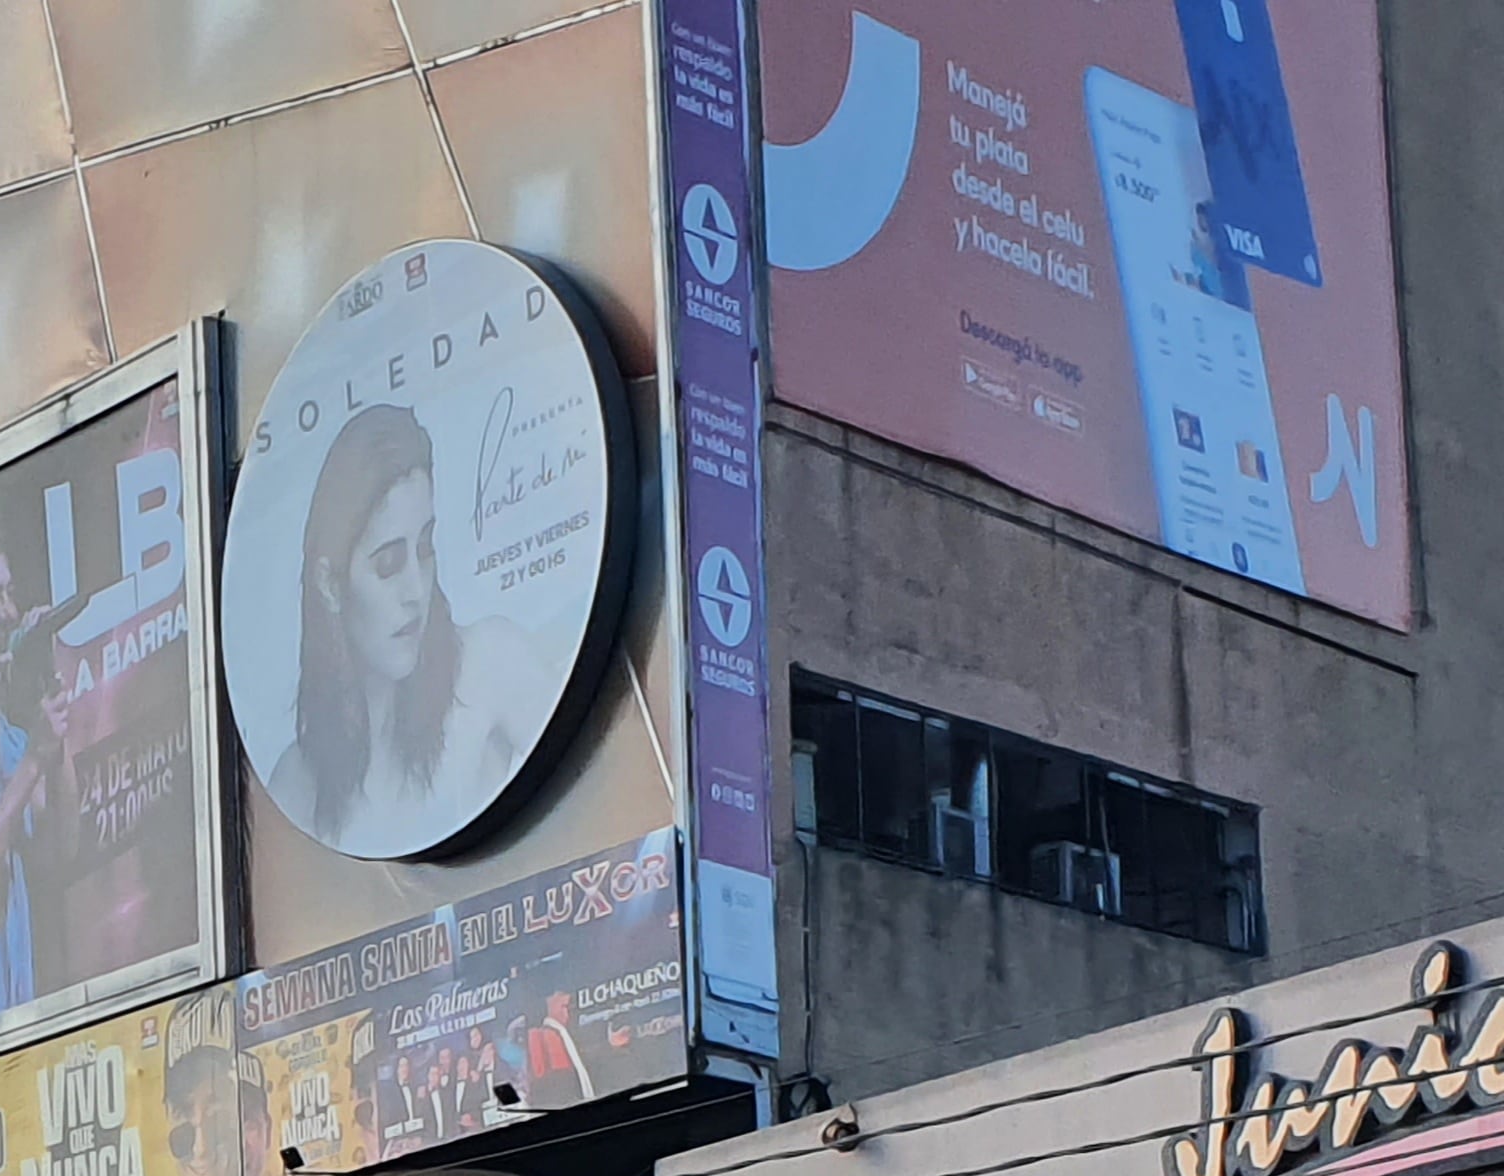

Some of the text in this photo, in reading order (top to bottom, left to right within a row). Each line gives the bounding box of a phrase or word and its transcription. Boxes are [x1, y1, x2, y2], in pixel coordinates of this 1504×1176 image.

[946, 60, 1028, 132] Manejá
[950, 115, 1030, 175] tu plata
[951, 161, 1086, 248] desde el celu
[954, 217, 969, 252] y
[972, 214, 1044, 277] hacela
[1223, 223, 1265, 261] VISA
[685, 281, 741, 316] SANCOR
[685, 299, 743, 336] SEGUROS
[254, 285, 546, 455] SOLEDAD
[474, 540, 523, 576] JUEVES
[535, 509, 591, 549] VIERNES
[102, 602, 189, 683] BARRA
[242, 953, 356, 1032] SEMANA
[360, 921, 454, 992] SANTA
[459, 912, 488, 956] EN
[492, 905, 517, 944] EL
[522, 853, 670, 934] LUXOR
[425, 976, 509, 1021] Palmeras
[36, 1044, 127, 1149] VIVO
[281, 1104, 341, 1151] NUNCA
[69, 1124, 96, 1154] QUE
